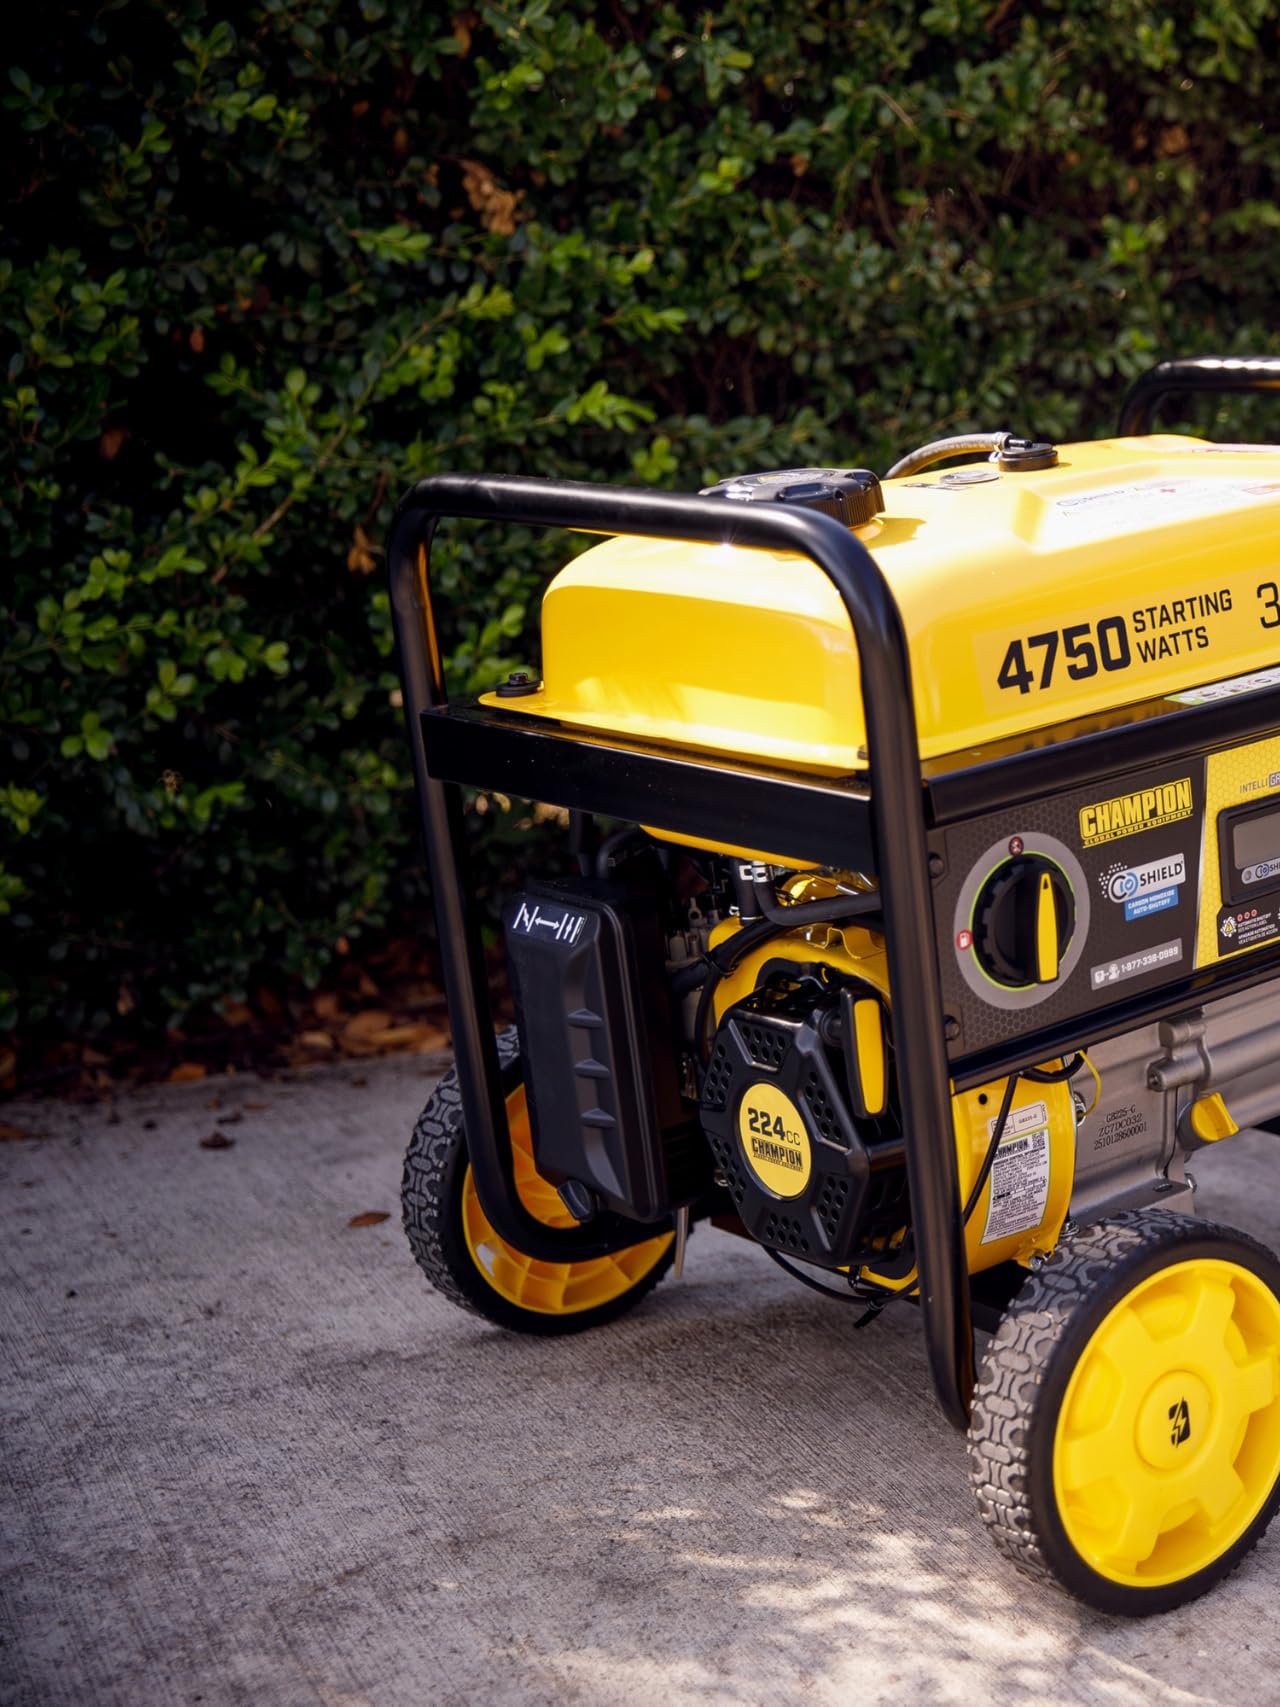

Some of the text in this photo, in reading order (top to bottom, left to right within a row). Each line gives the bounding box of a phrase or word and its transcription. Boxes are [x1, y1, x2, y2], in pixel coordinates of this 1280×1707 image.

[1132, 588, 1233, 633] STARTING
[996, 615, 1133, 696] 4750
[1136, 625, 1210, 664] WATTS
[1080, 778, 1193, 840] CHAMPION
[751, 1136, 803, 1168] CHAMPION
